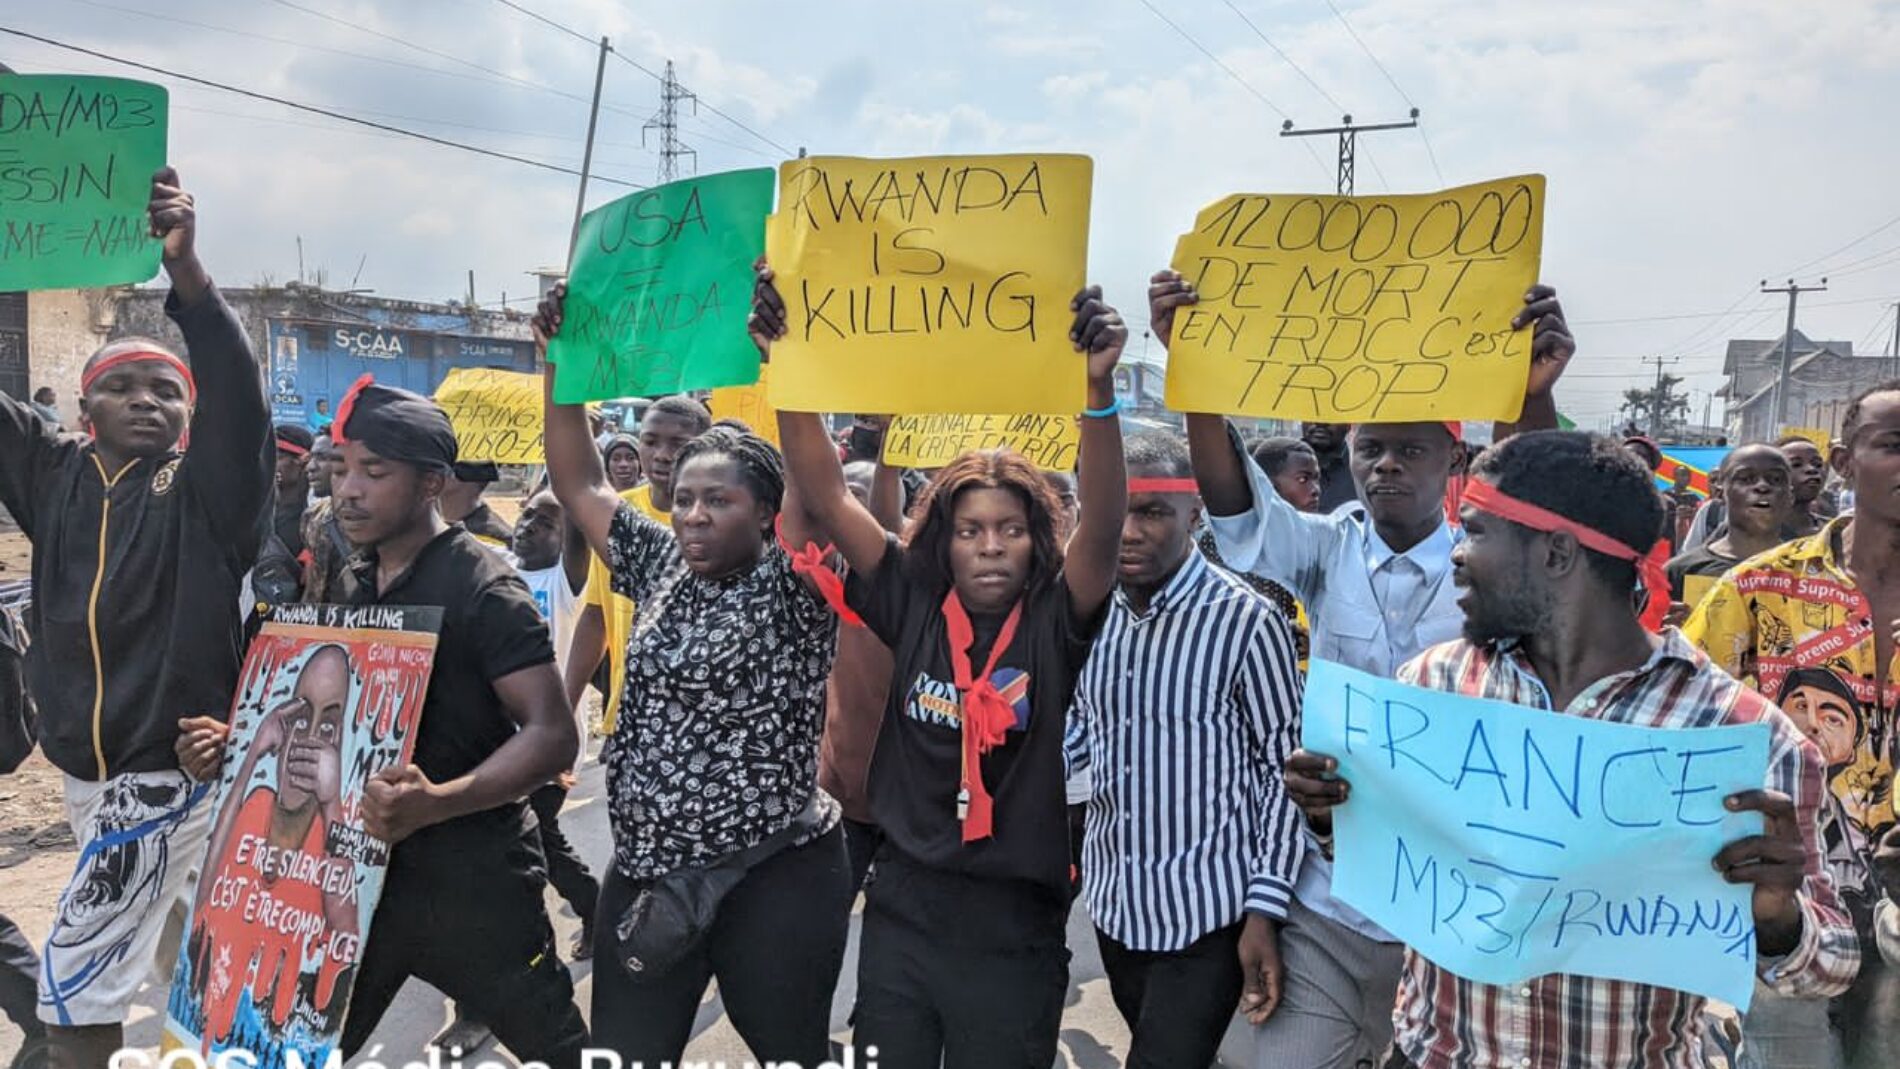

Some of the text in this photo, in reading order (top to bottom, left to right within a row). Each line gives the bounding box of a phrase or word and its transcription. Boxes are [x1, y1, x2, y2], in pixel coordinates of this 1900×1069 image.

[600, 186, 709, 254] USA
[788, 160, 1048, 231] RWANDA
[872, 227, 946, 276] IS
[572, 281, 722, 345] RWANDA
[802, 270, 1037, 342] KILLING
[1194, 256, 1507, 318] DE MORT
[1178, 310, 1246, 353] EN
[1267, 314, 1411, 364] RDC
[887, 434, 911, 456] LA
[1021, 438, 1077, 470] RDC
[325, 605, 339, 628] IS
[343, 606, 405, 631] KILLING
[1343, 683, 1745, 829] FRANCE
[278, 849, 361, 906] SILENCIEUX
